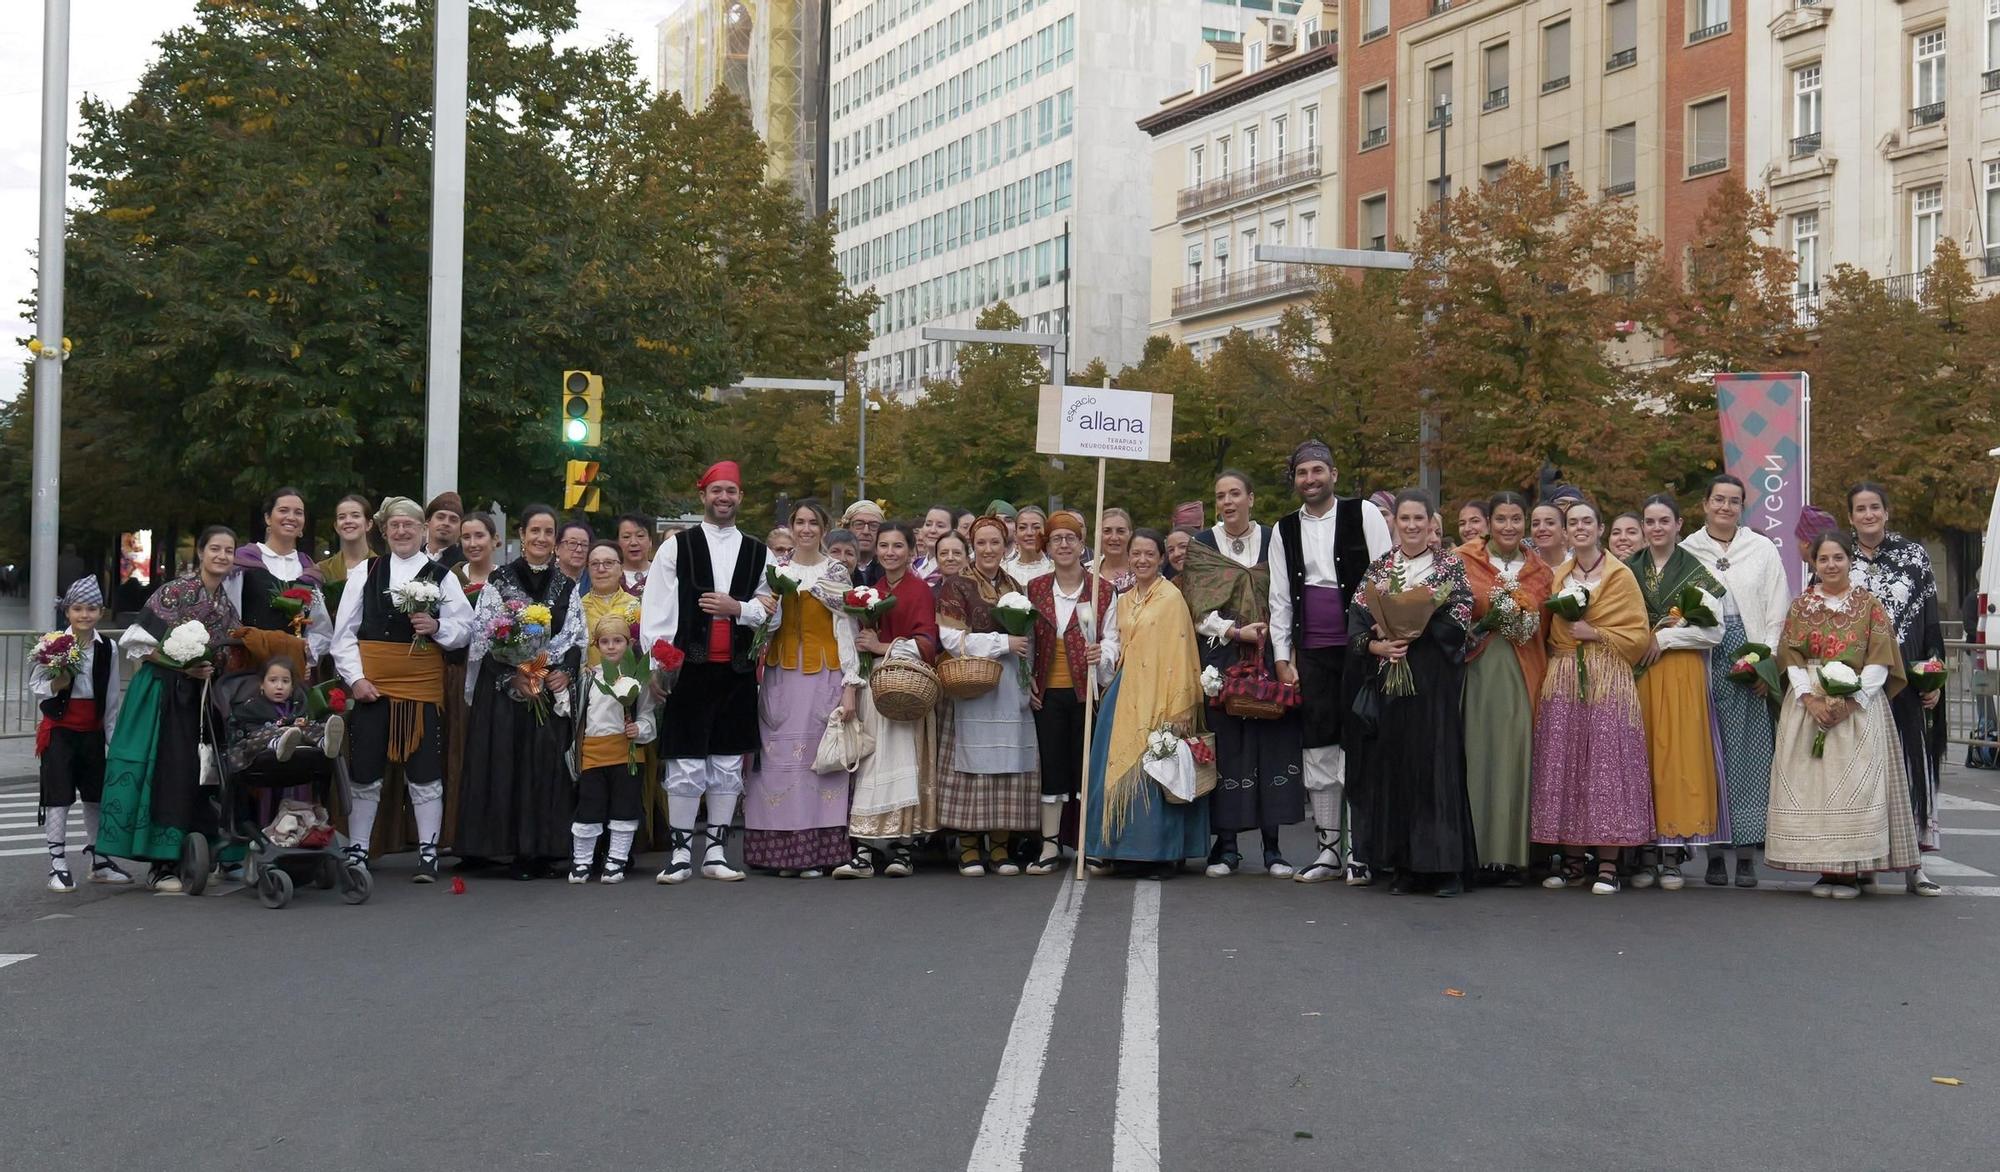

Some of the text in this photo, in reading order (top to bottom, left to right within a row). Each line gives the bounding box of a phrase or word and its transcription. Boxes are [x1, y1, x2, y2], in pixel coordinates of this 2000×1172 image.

[1067, 395, 1096, 422] espacio
[1080, 411, 1144, 433] allana
[1080, 442, 1143, 452] NEURODESARROLLO
[1107, 437, 1137, 445] TERAPIAS
